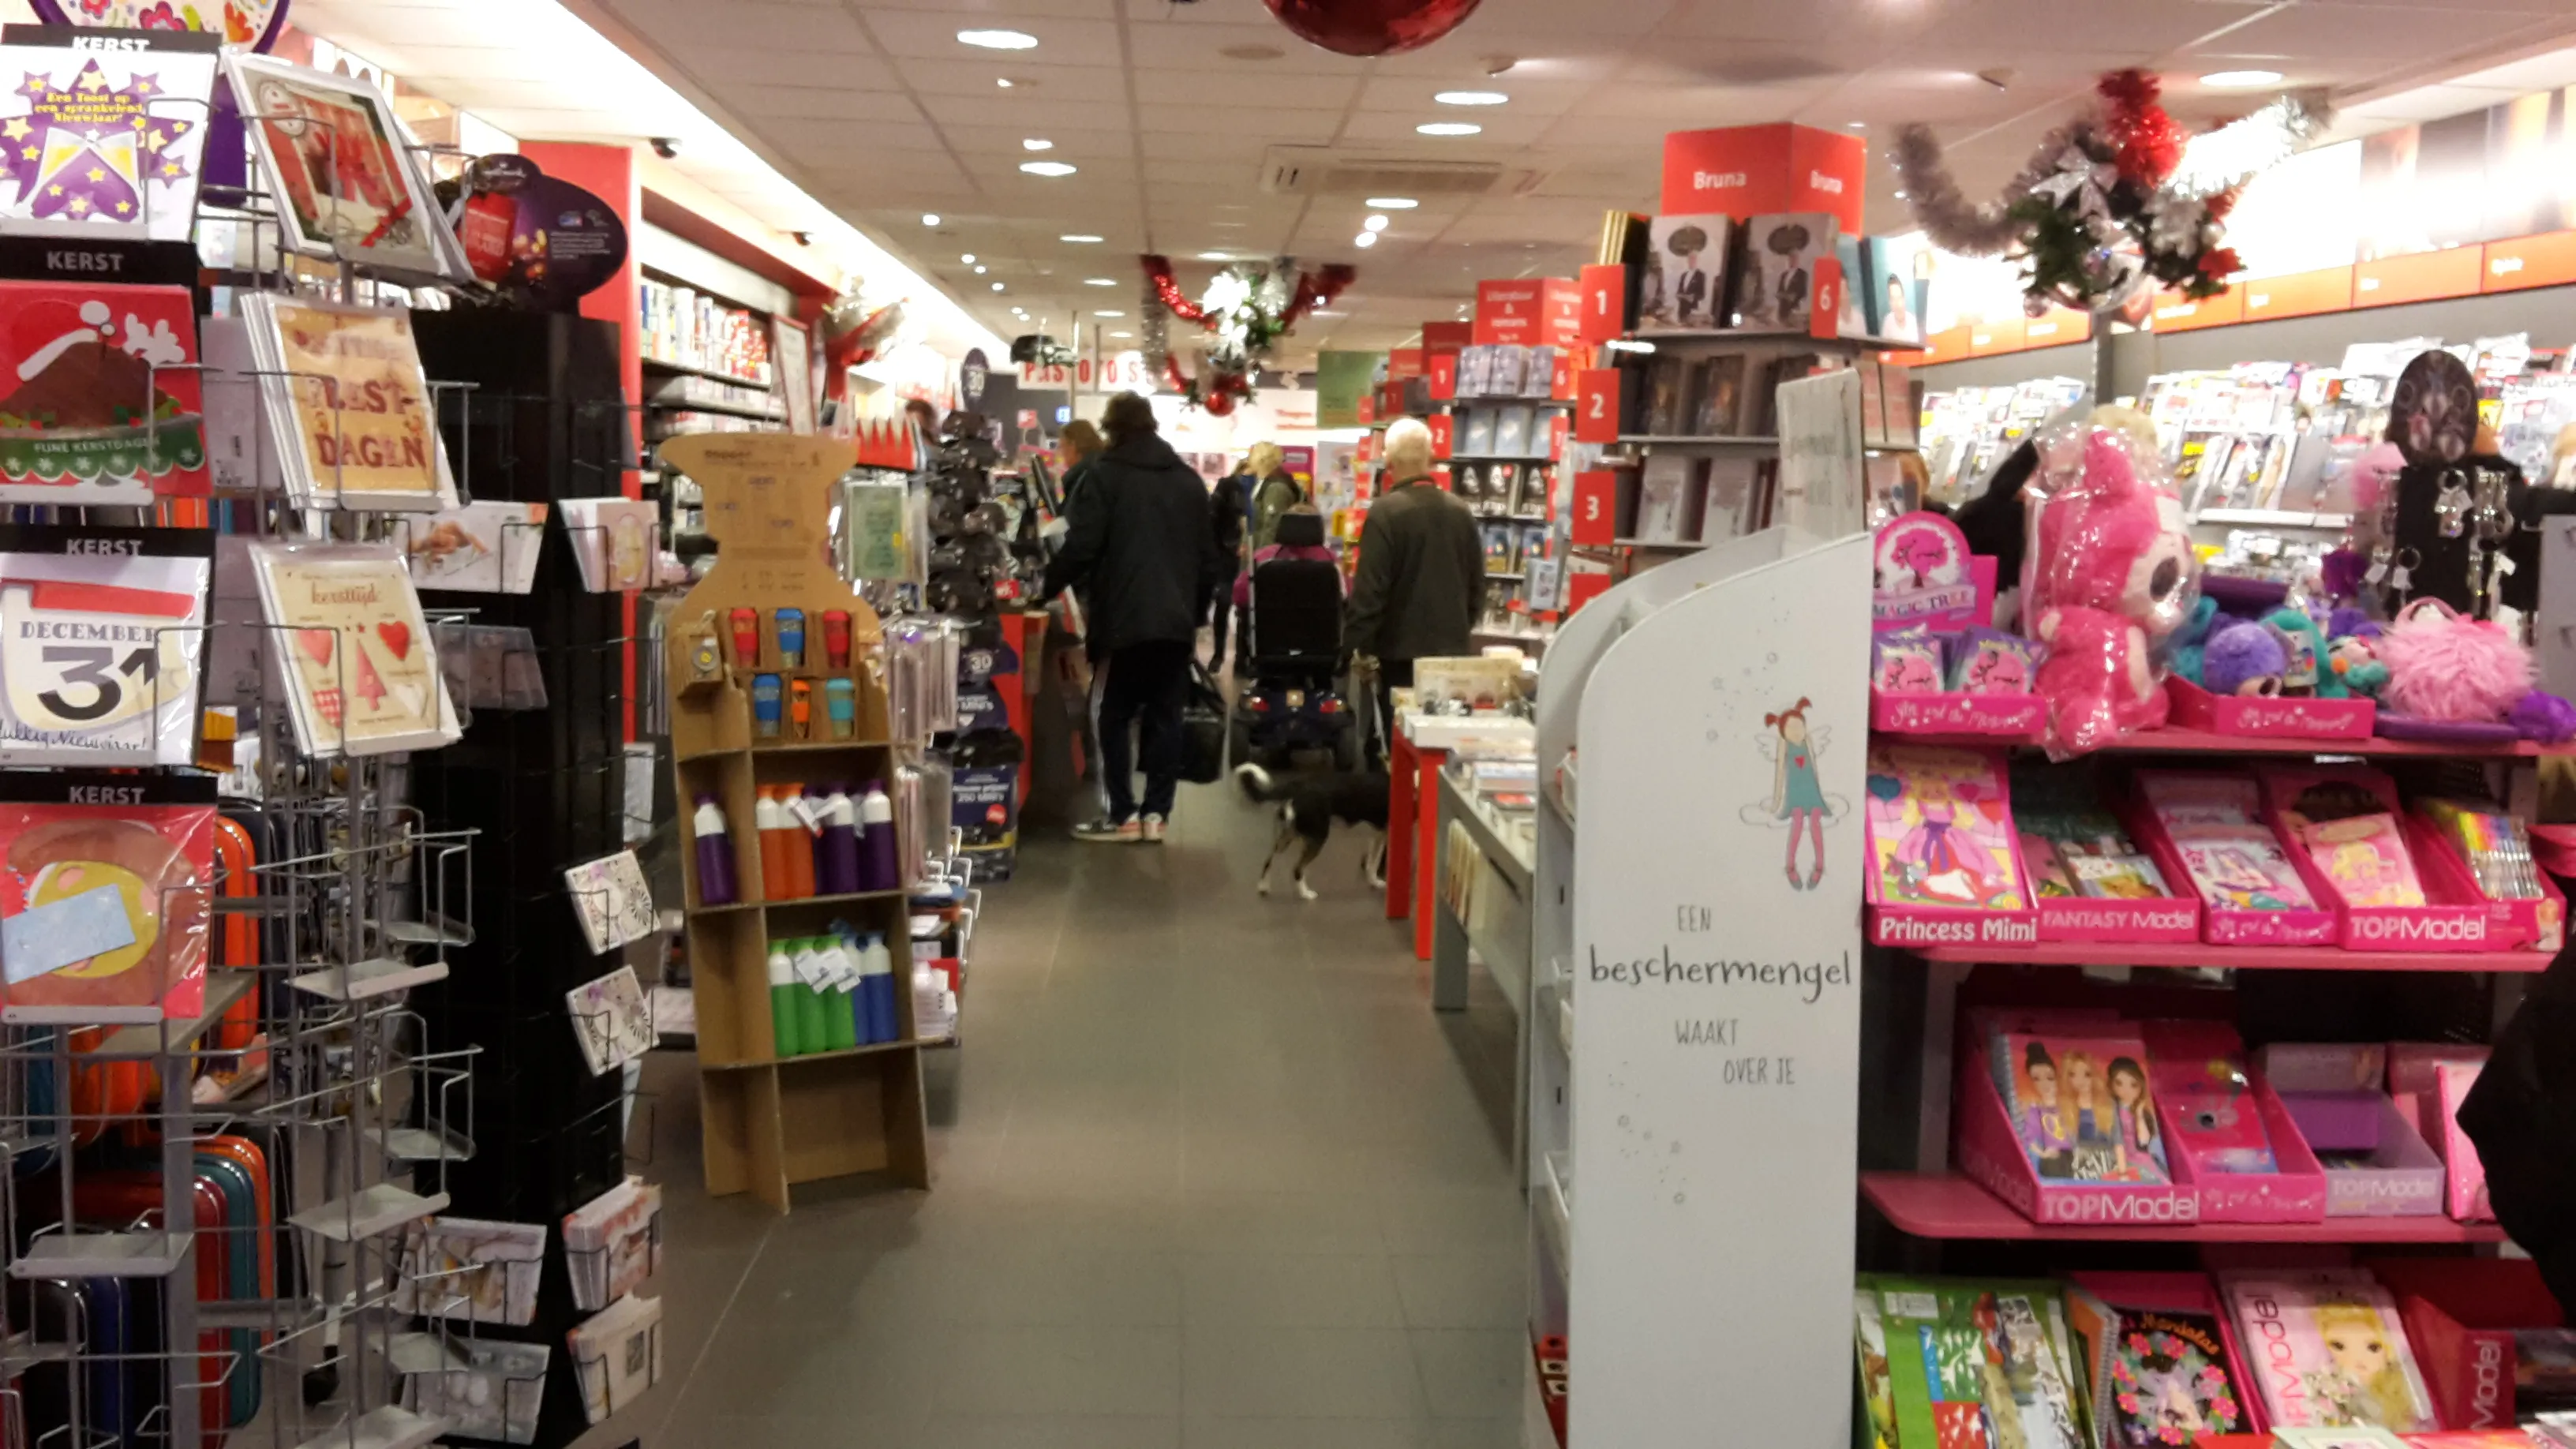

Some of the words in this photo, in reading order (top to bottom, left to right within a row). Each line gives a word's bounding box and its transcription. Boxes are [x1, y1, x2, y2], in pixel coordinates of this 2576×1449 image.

[72, 36, 150, 52] KERST
[1694, 170, 1747, 189] Bruna
[1811, 170, 1843, 194] Bruna
[47, 250, 124, 271] KERST
[1594, 290, 1607, 315] 1
[1820, 287, 1831, 310] 6
[1438, 369, 1446, 384] 1
[1556, 369, 1566, 386] 6
[1589, 392, 1605, 419] 2
[1436, 429, 1444, 444] 2
[315, 432, 427, 467] DAGEN
[1586, 496, 1600, 521] 3
[66, 538, 144, 555] KERST
[20, 620, 161, 642] DECEMBER
[37, 646, 159, 721] 31
[69, 785, 146, 804] KERST
[1677, 904, 1711, 932] EEN
[1880, 916, 1975, 942] Princess
[1982, 916, 2037, 942] Mimi
[2042, 911, 2129, 929] FANTASY
[2132, 909, 2196, 930] Model
[2349, 913, 2485, 941] TOPModel
[1589, 943, 1851, 1004] beschermengel
[1675, 1018, 1739, 1046] WAAKT
[1723, 1057, 1768, 1085] OVER
[1776, 1057, 1795, 1085] JE
[2334, 1176, 2438, 1197] TOPModel
[2044, 1191, 2200, 1221] TOPModel
